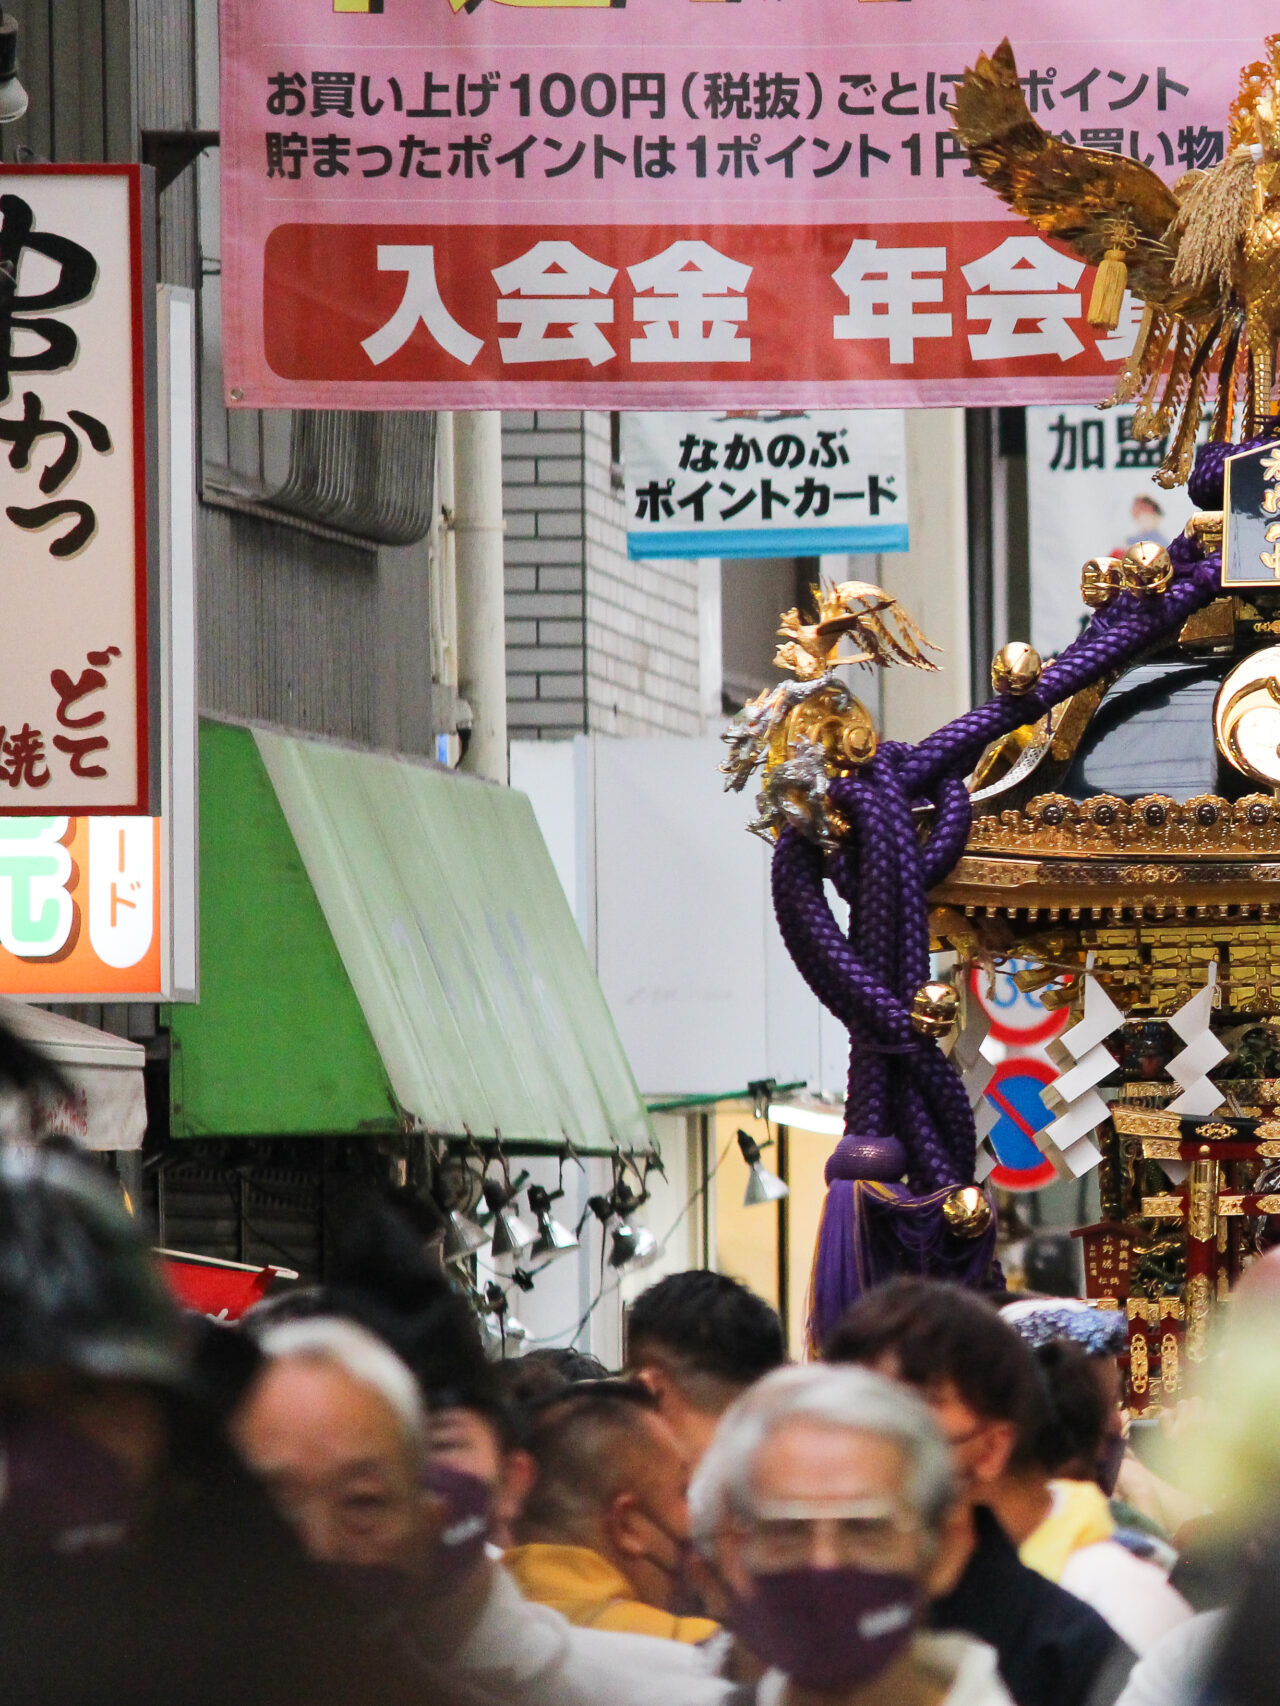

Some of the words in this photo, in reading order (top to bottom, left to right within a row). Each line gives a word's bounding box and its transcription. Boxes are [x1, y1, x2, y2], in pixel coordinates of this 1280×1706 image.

[265, 66, 1190, 119] お買い上げ100円（税抜）ごとにポイント
[360, 239, 751, 367] 入会金
[833, 236, 1180, 365] 年会
[677, 427, 852, 474] なかのぶ
[634, 473, 899, 523] ポイントカード
[50, 645, 122, 778] どて
[110, 828, 142, 929] ード
